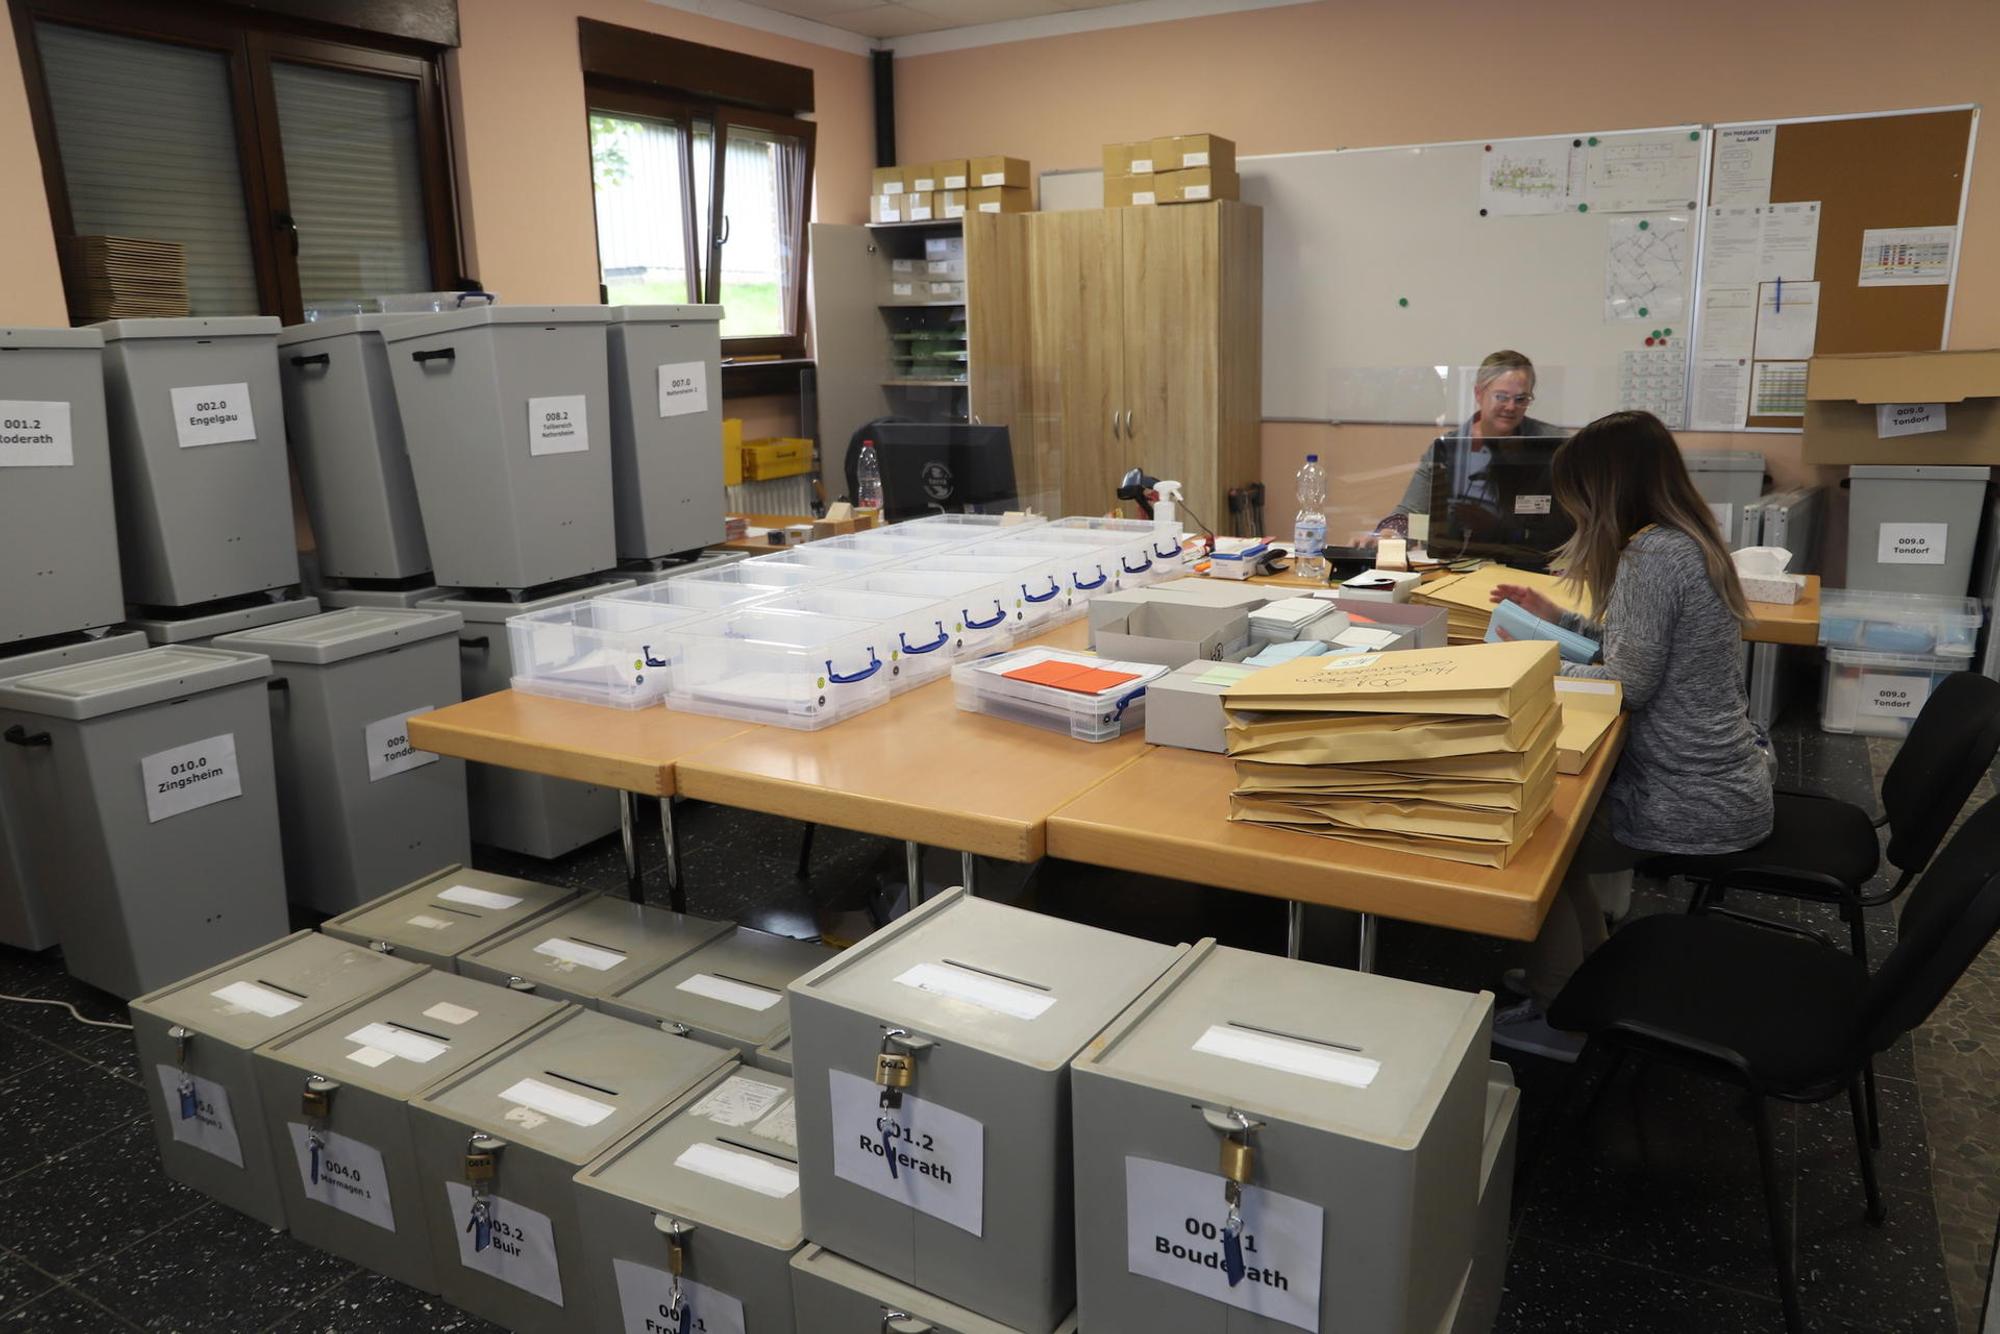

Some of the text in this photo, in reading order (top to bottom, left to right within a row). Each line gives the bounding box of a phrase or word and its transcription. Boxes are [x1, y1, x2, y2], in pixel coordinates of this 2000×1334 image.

[196, 400, 227, 412] 002.0
[1896, 406, 1924, 415] 009.0
[189, 412, 238, 427] Engelgau
[545, 411, 569, 422] 008.2
[1893, 415, 1930, 425] Tondorf
[4, 419, 41, 429] 001.2
[1898, 537, 1925, 545] 009.0
[1893, 546, 1930, 555] Tondorf
[1879, 689, 1907, 699] 009.0
[1873, 699, 1910, 709] Tondorf
[170, 757, 207, 776] 010.0
[158, 766, 224, 794] Zingsheim
[326, 1160, 361, 1182] 004.0
[490, 1219, 525, 1242] 03.2
[1185, 1217, 1258, 1253] 001
[492, 1236, 522, 1257] Buir
[1155, 1235, 1289, 1291] Boudeath
[659, 1304, 708, 1333] 00.1
